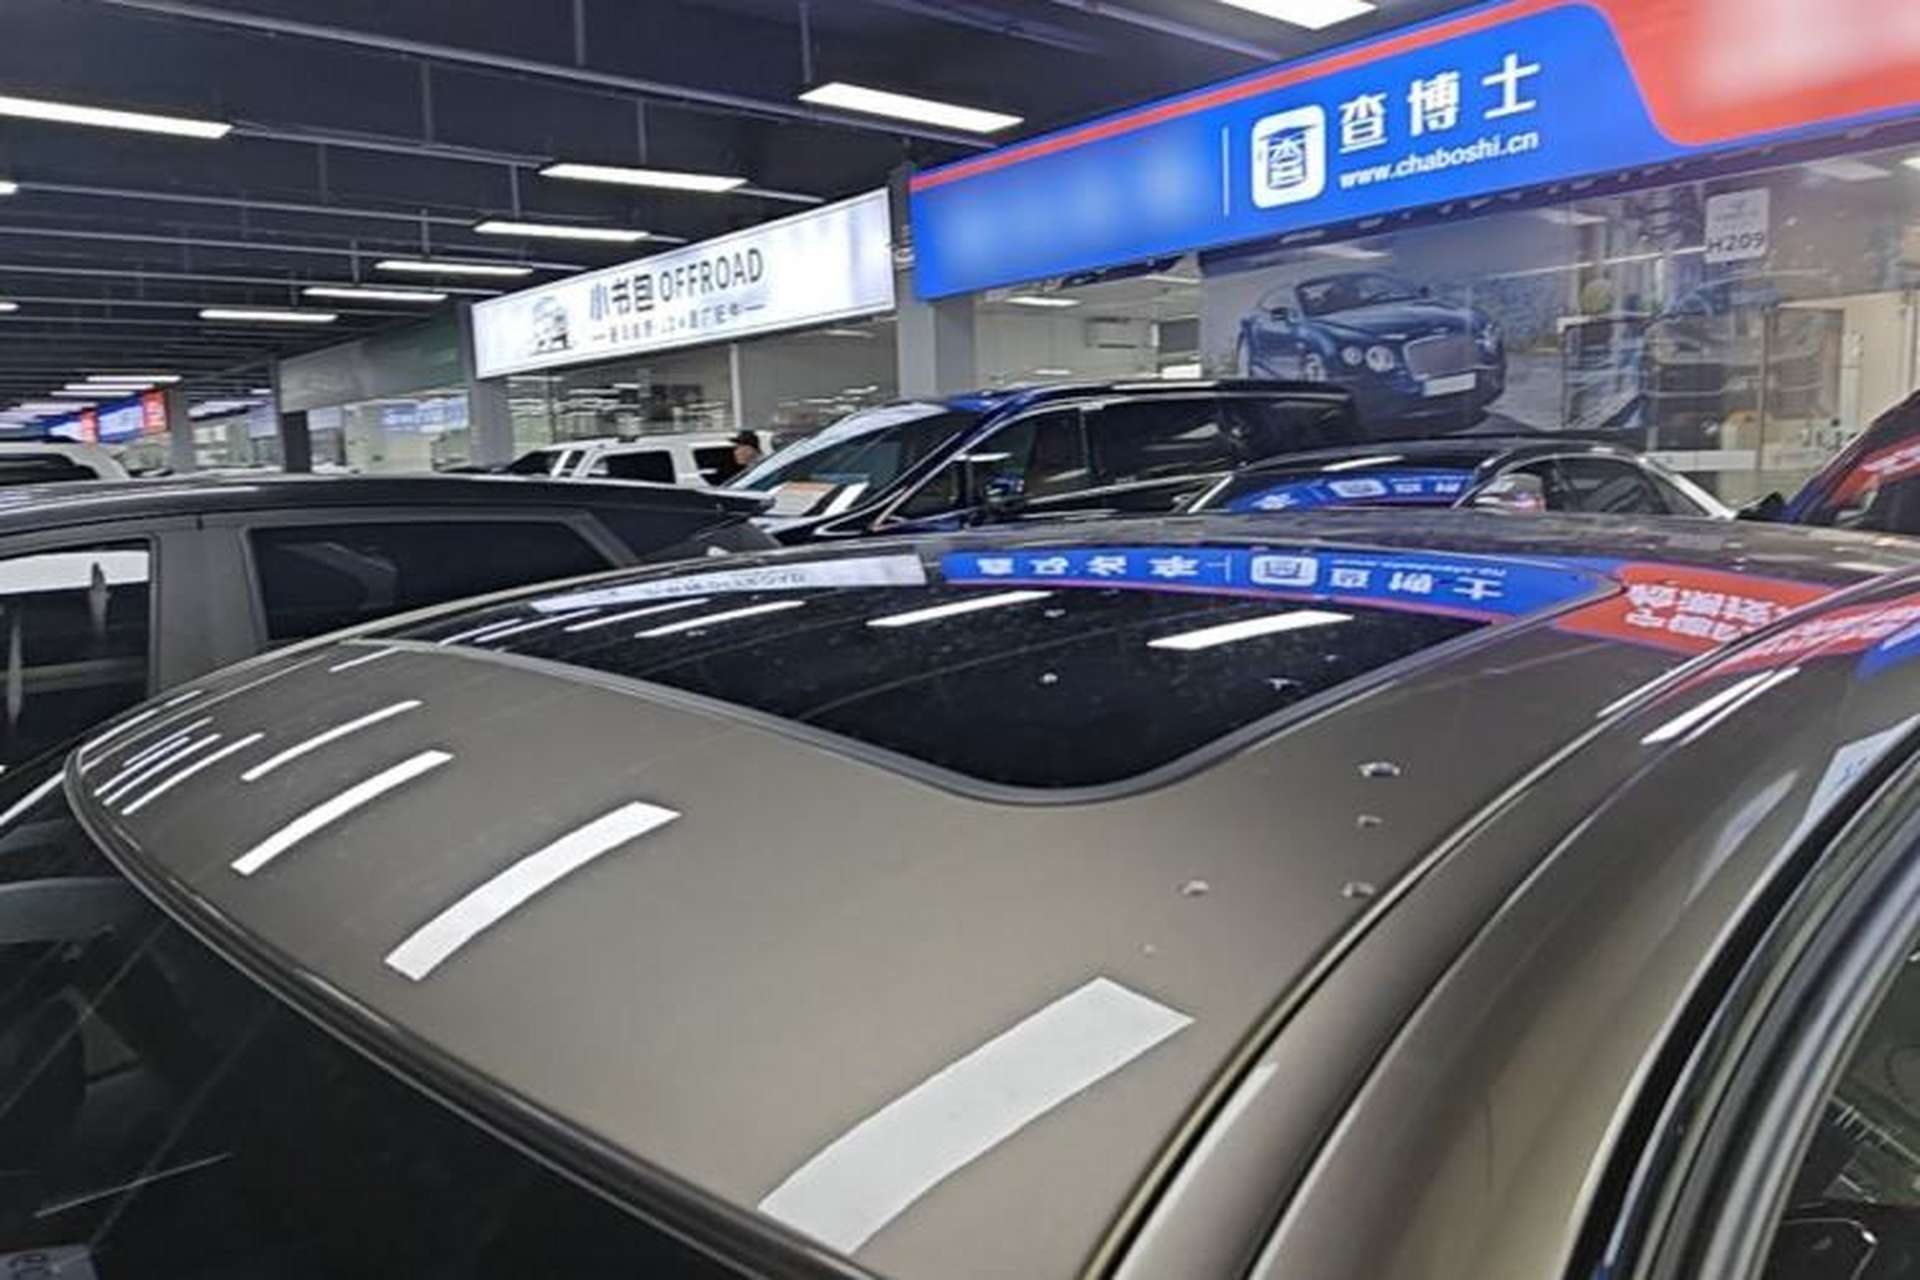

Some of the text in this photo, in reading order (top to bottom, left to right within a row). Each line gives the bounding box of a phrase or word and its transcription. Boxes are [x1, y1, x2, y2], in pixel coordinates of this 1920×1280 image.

[1338, 53, 1541, 154] 查博士
[1339, 131, 1539, 189] www.chaboshi.cn
[1708, 231, 1766, 253] H209
[659, 247, 764, 303] OFFROAD
